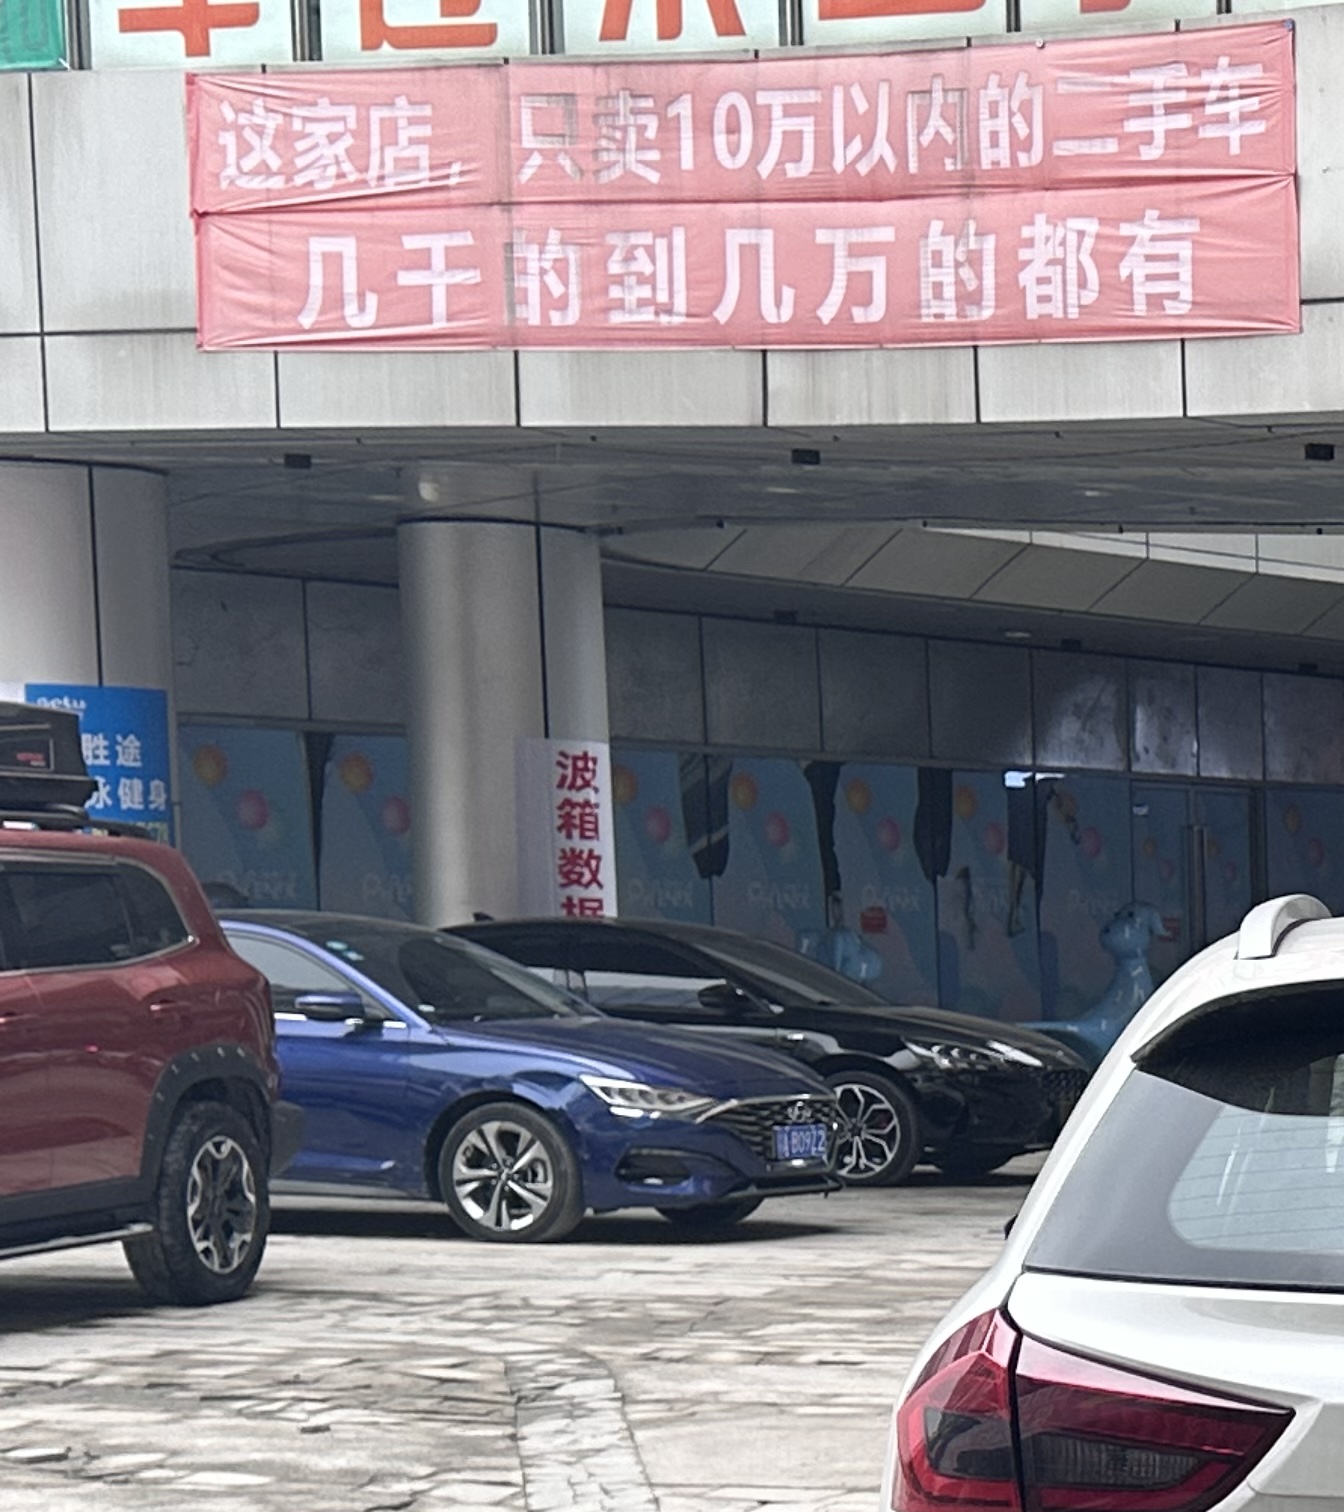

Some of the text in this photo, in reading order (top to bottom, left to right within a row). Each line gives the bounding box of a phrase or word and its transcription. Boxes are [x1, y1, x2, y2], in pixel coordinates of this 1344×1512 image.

[297, 210, 1200, 330] 几千的到几万的都有
